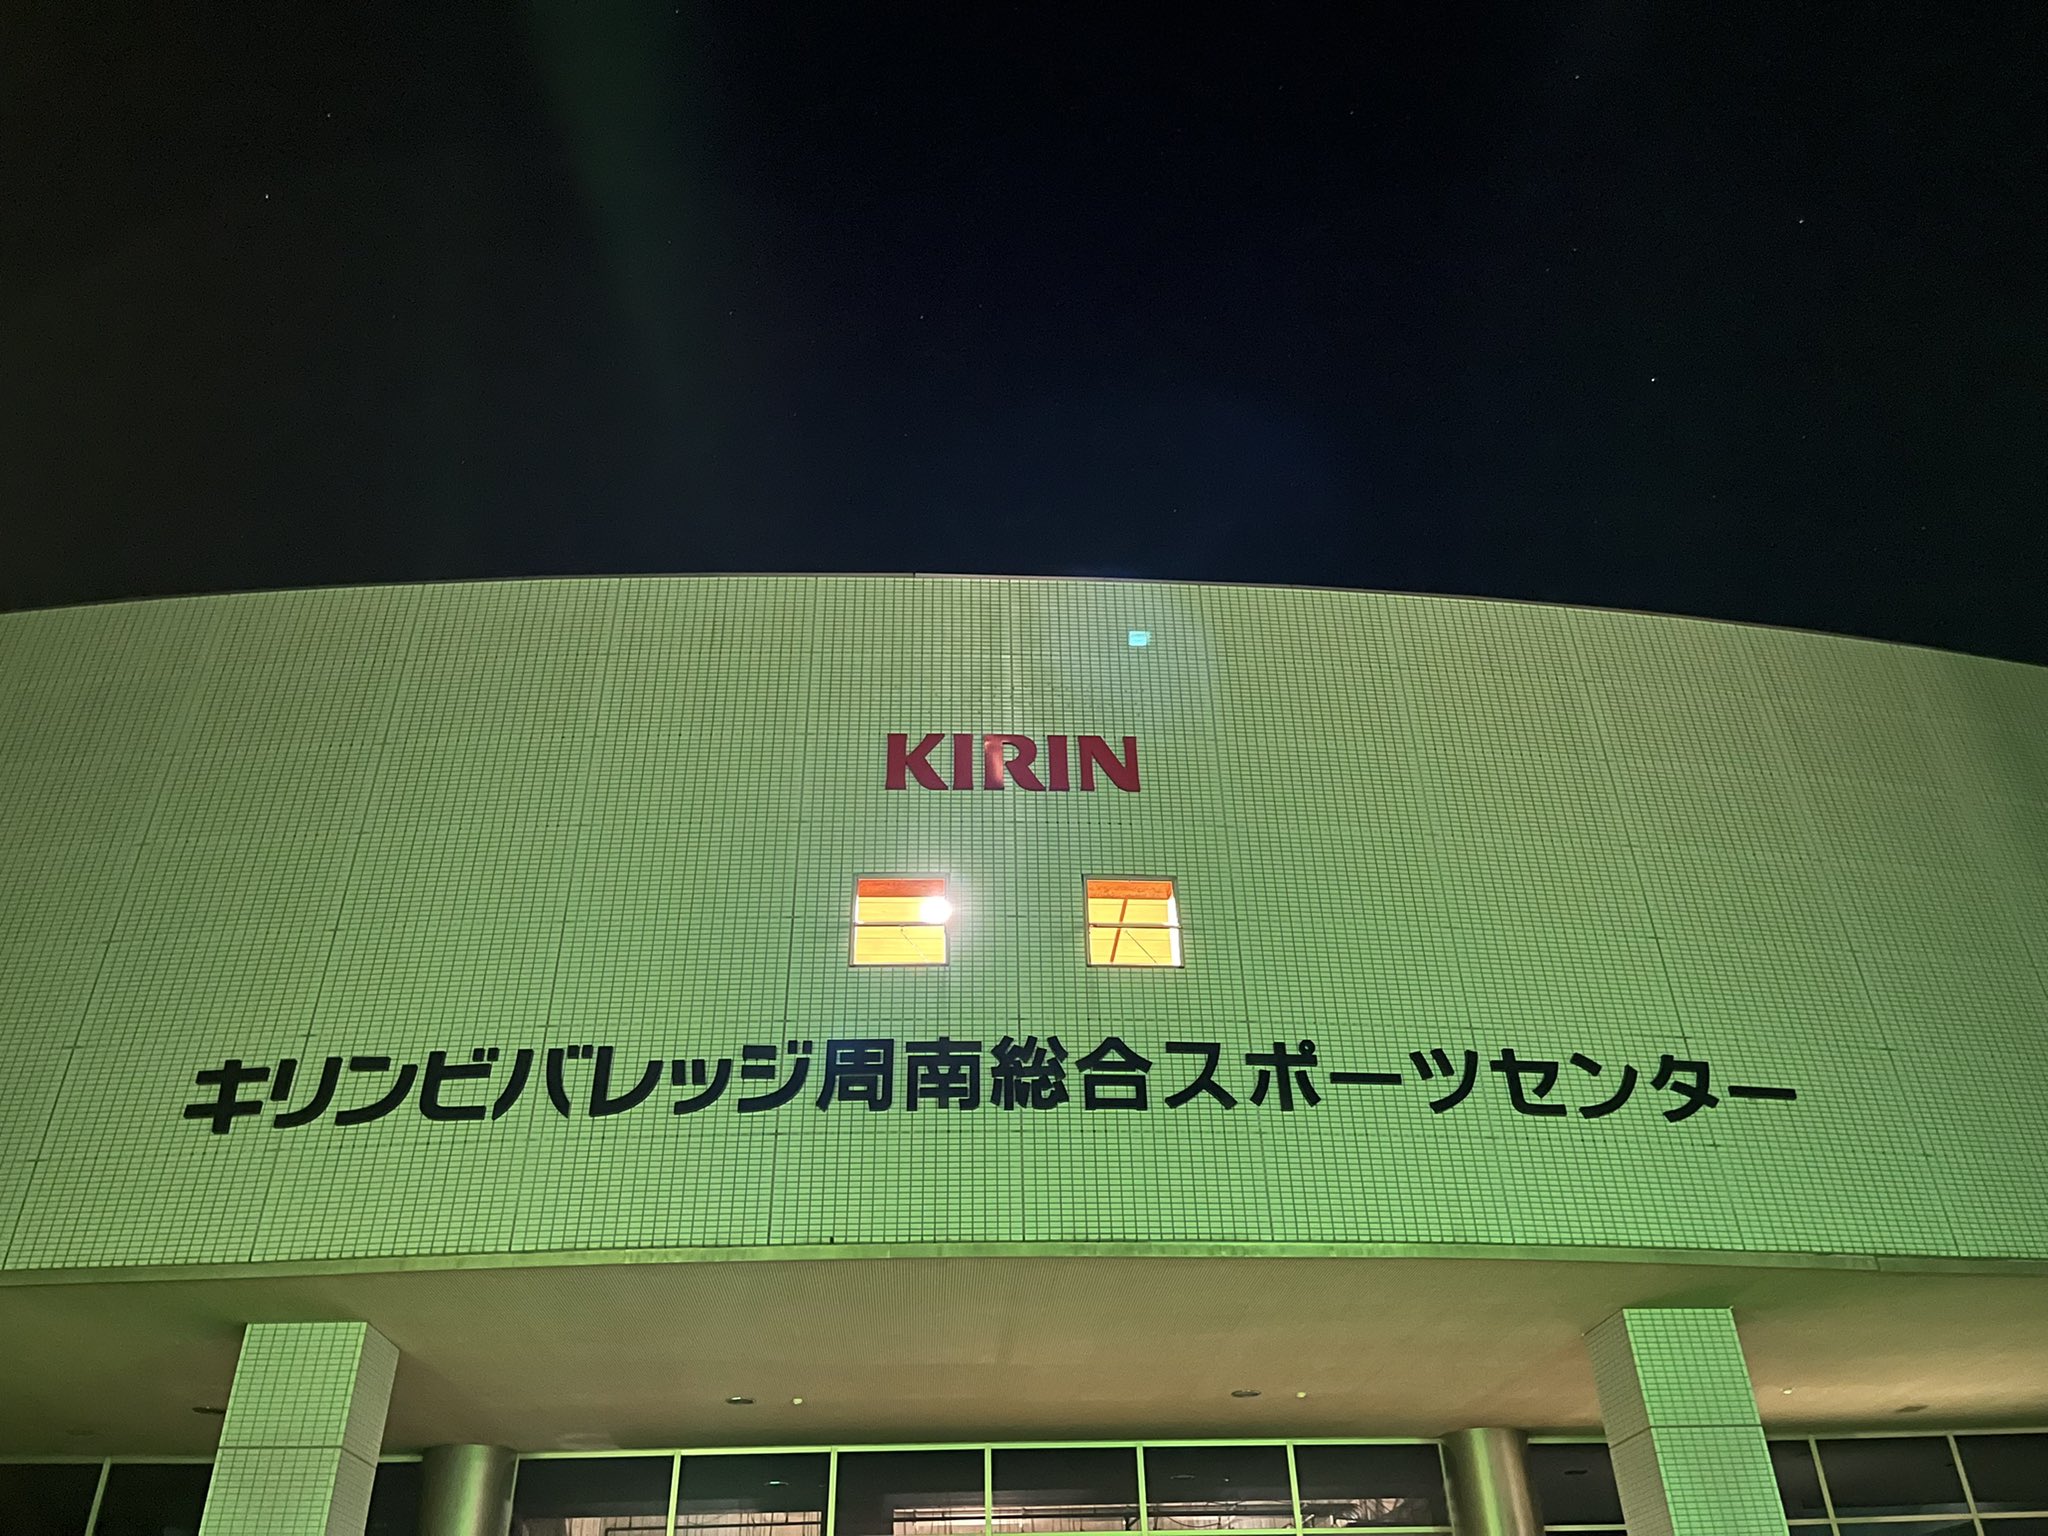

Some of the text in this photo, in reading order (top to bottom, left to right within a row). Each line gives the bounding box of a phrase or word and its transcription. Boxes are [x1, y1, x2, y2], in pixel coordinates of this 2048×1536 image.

[885, 733, 1141, 792] KIRIN
[183, 1036, 1797, 1134] キリンビバレッジ周南総合スポーツセンター
